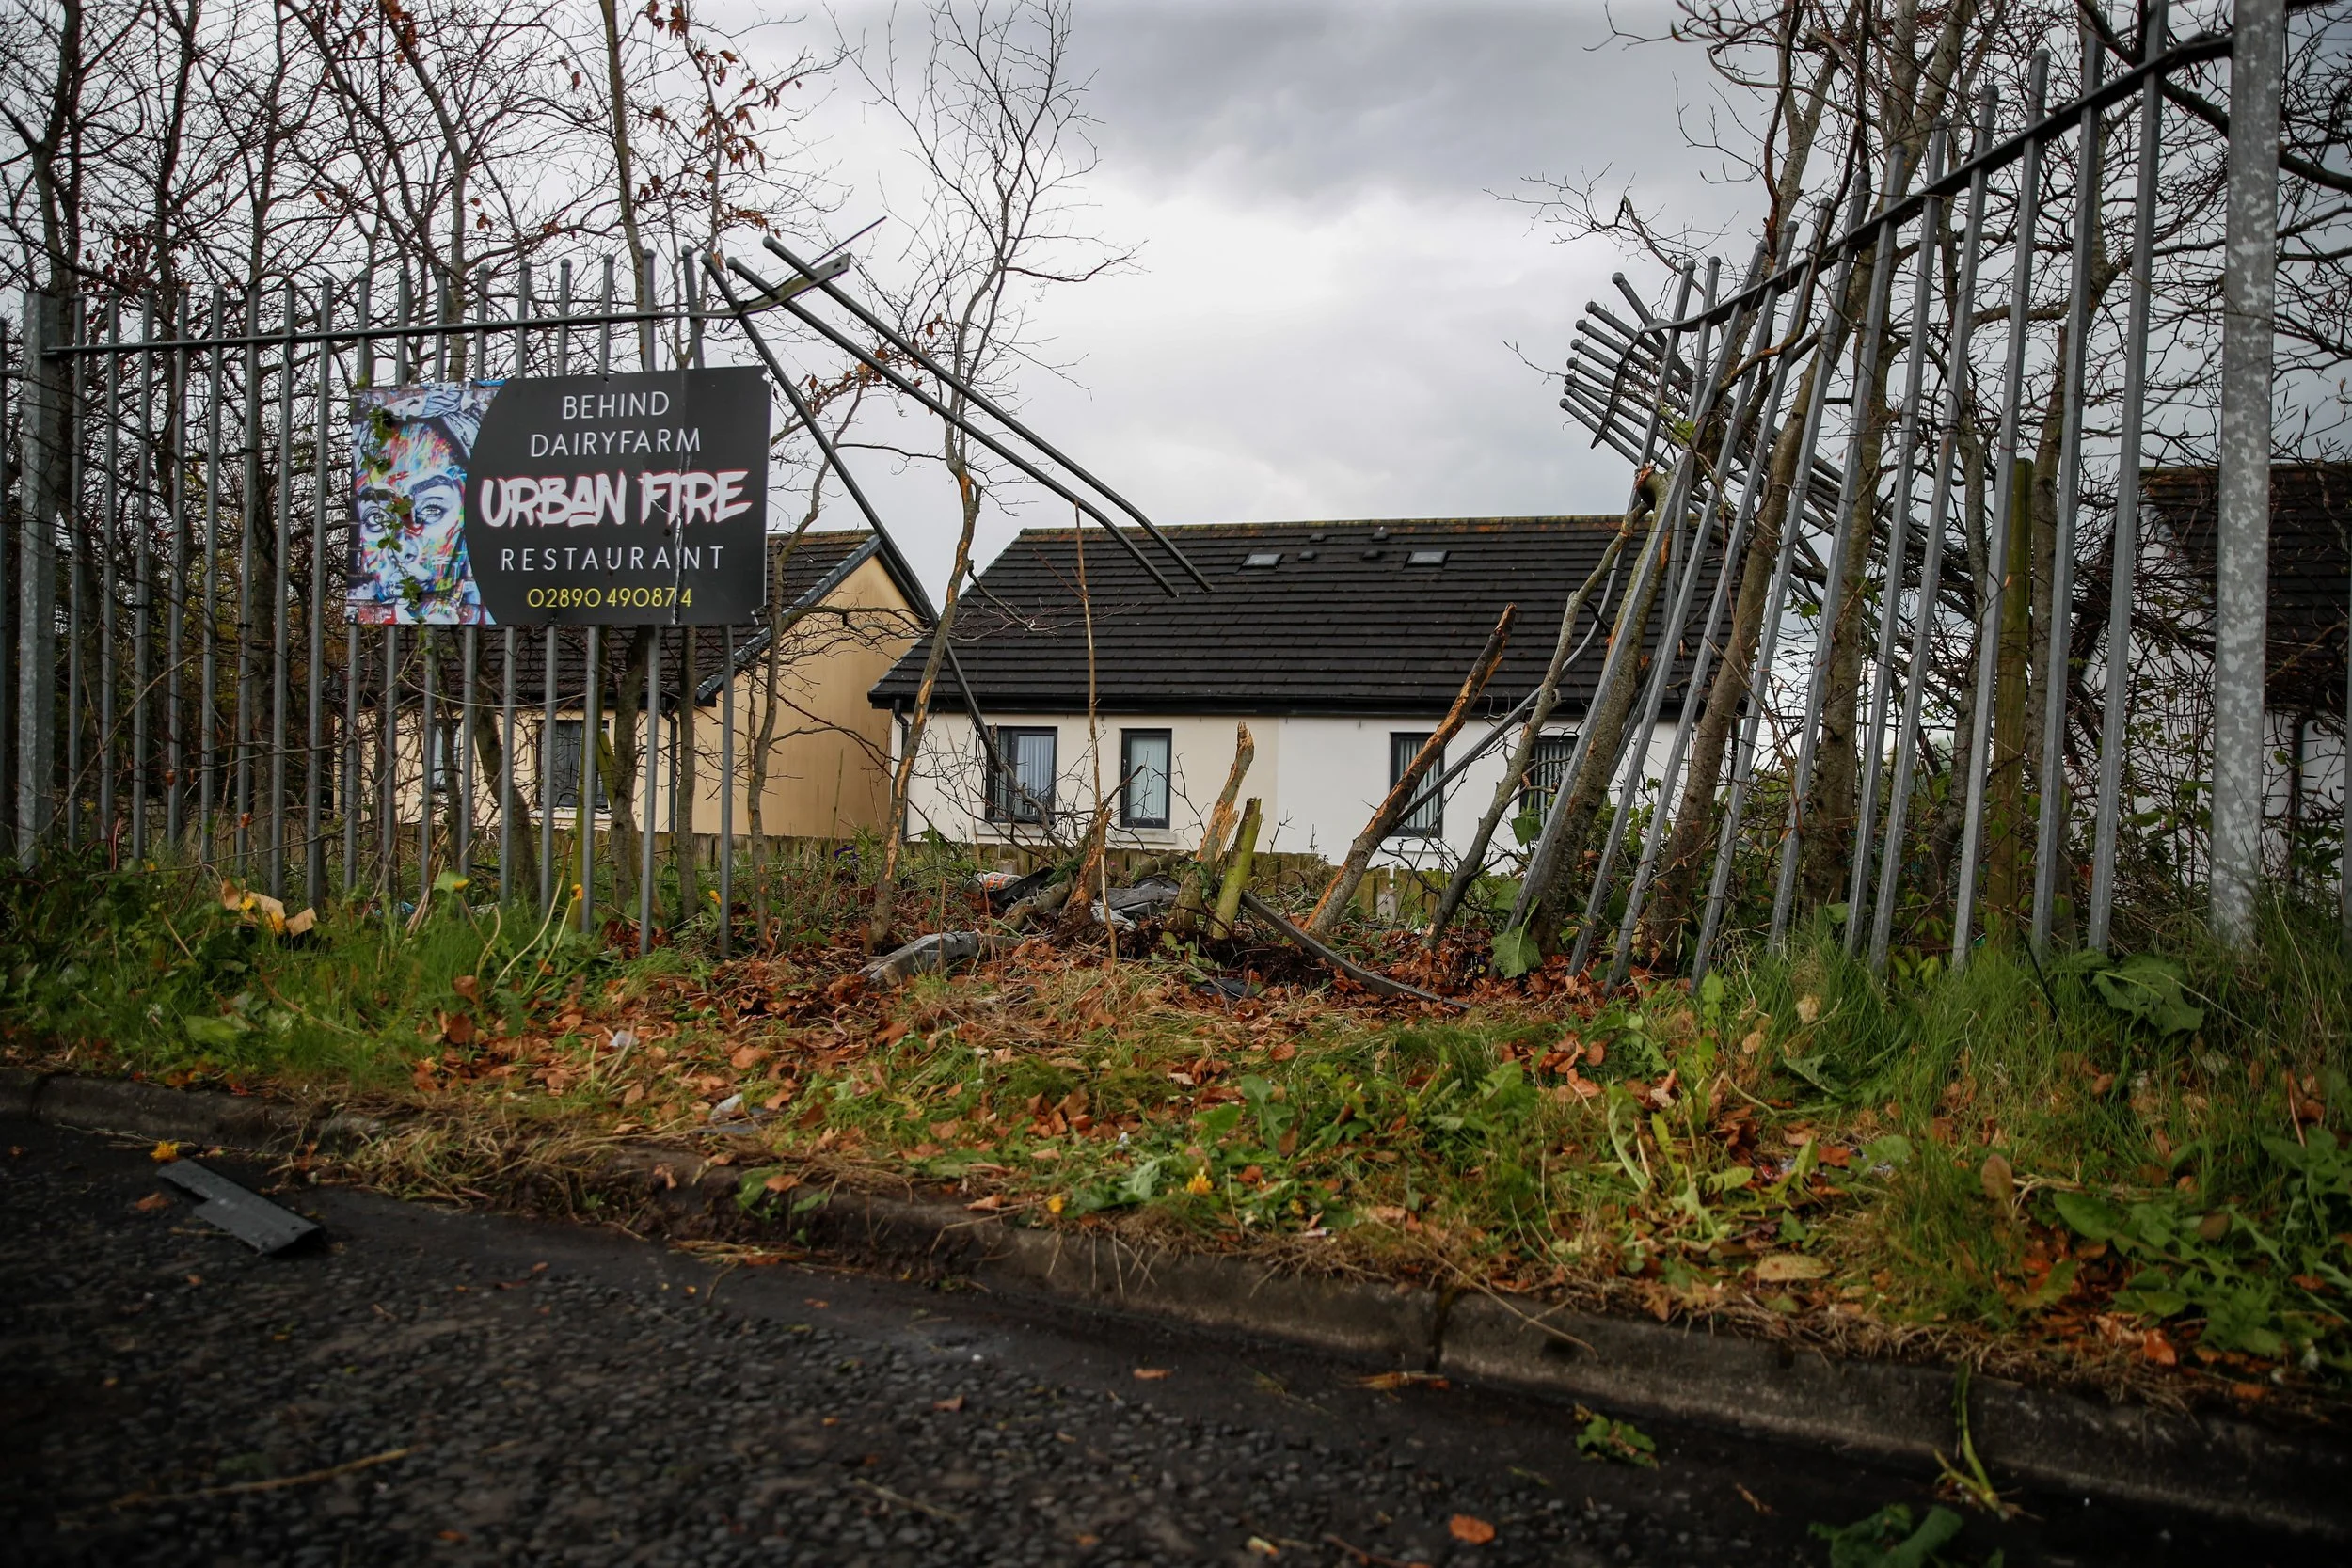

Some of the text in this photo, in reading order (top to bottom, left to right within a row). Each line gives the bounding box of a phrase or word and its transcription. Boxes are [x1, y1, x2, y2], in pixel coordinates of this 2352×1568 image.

[564, 392, 670, 420] BEHIND
[530, 428, 701, 458] DAIRYFARM
[480, 470, 753, 528] URBAN FIRE
[501, 546, 723, 571] RESTAURANT
[527, 587, 692, 608] 02890 490874
